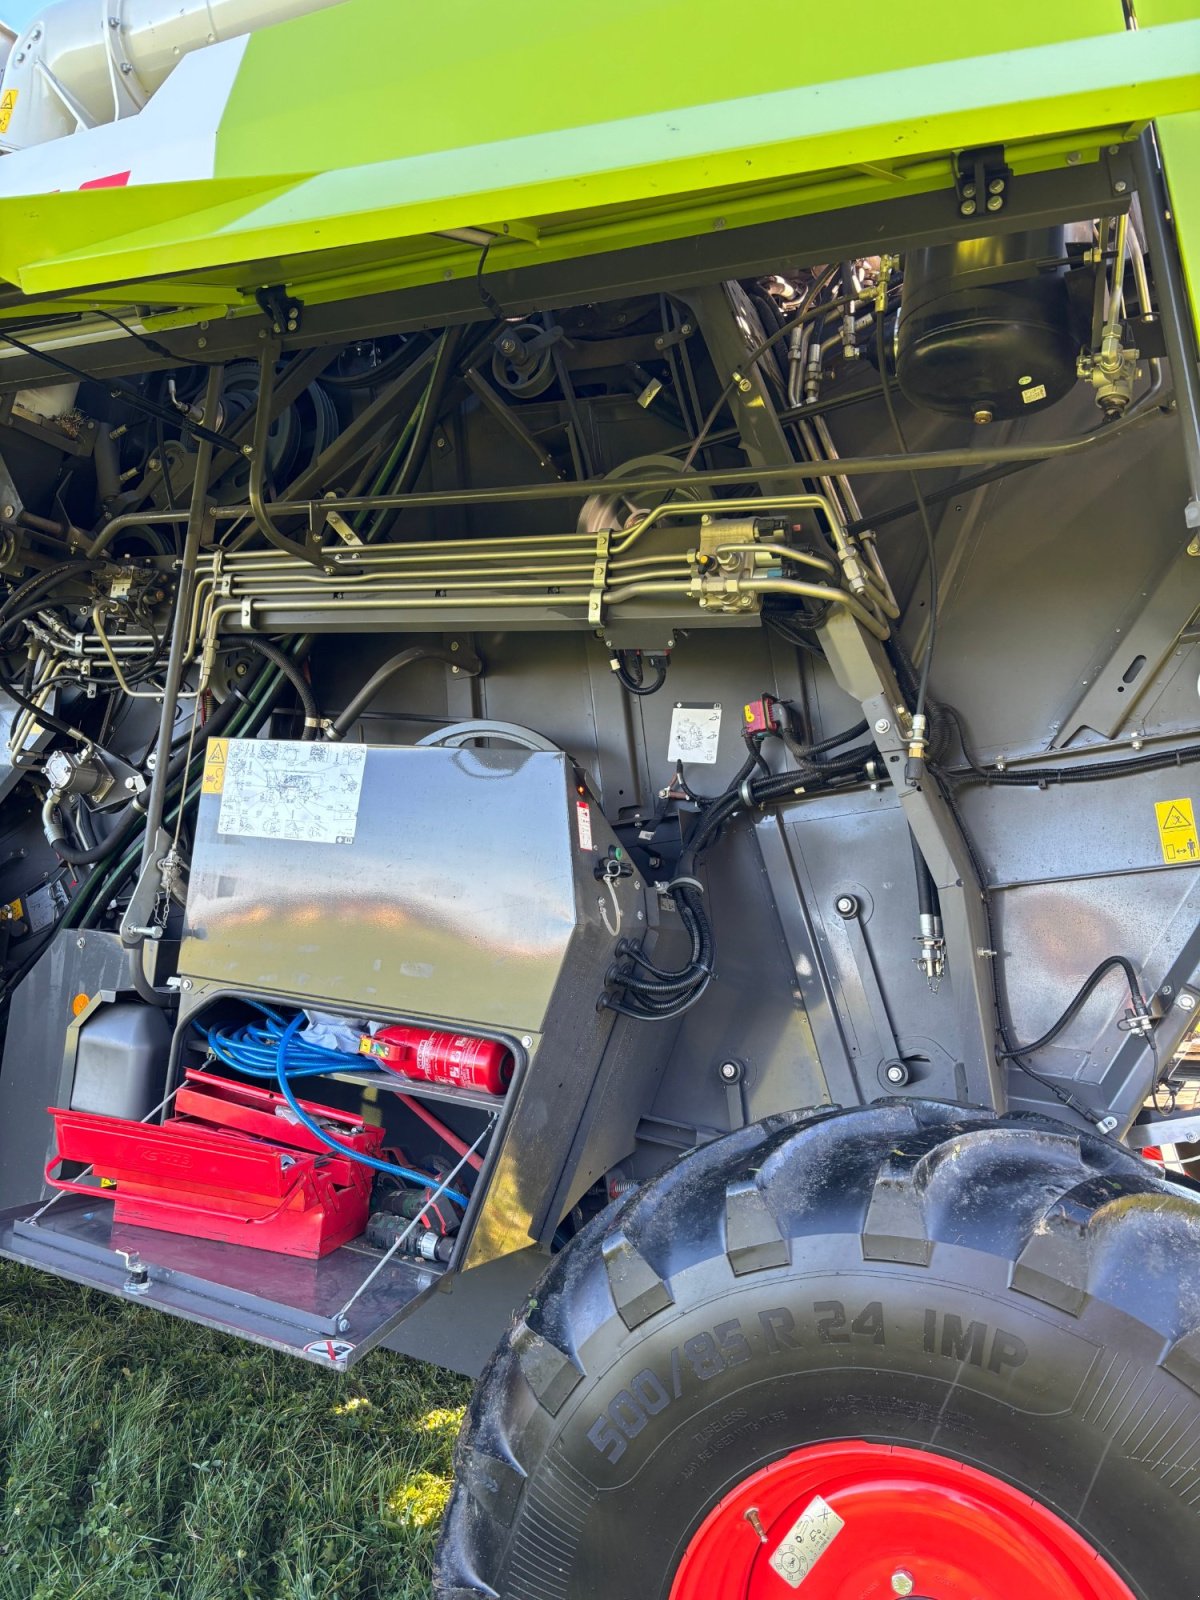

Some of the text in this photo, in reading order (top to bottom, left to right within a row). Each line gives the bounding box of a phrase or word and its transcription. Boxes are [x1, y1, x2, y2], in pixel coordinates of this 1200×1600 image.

[586, 1300, 1028, 1465] 500/85 R 24 IMP
[692, 1407, 748, 1444] TUBELESS
